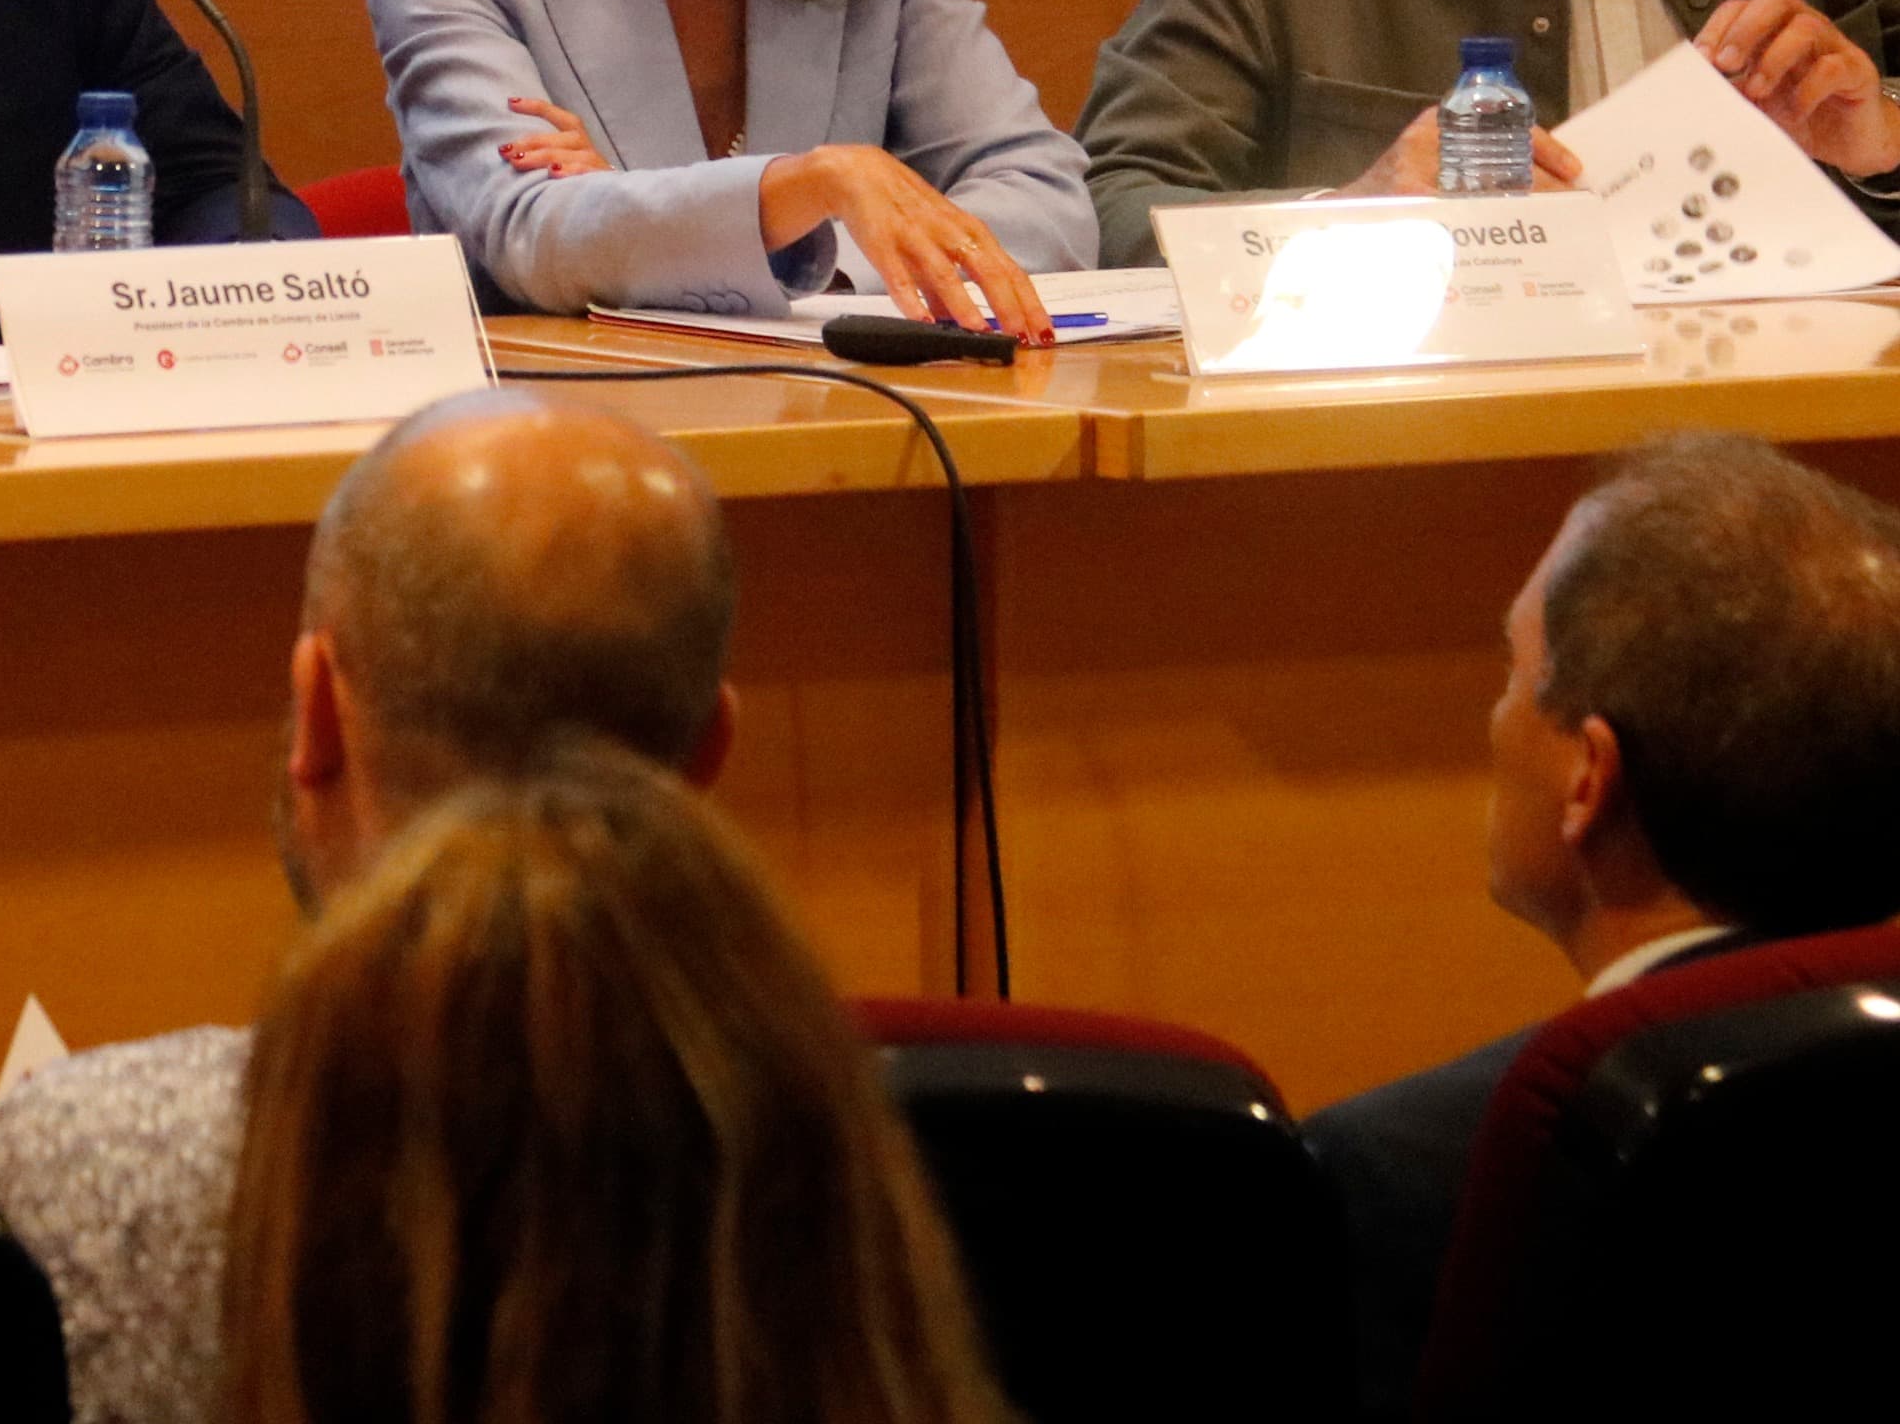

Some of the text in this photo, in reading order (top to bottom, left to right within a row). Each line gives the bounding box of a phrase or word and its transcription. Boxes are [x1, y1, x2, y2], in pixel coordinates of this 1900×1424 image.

[1440, 218, 1548, 248] oveda
[110, 270, 371, 311] Sr. Jaume Saltó
